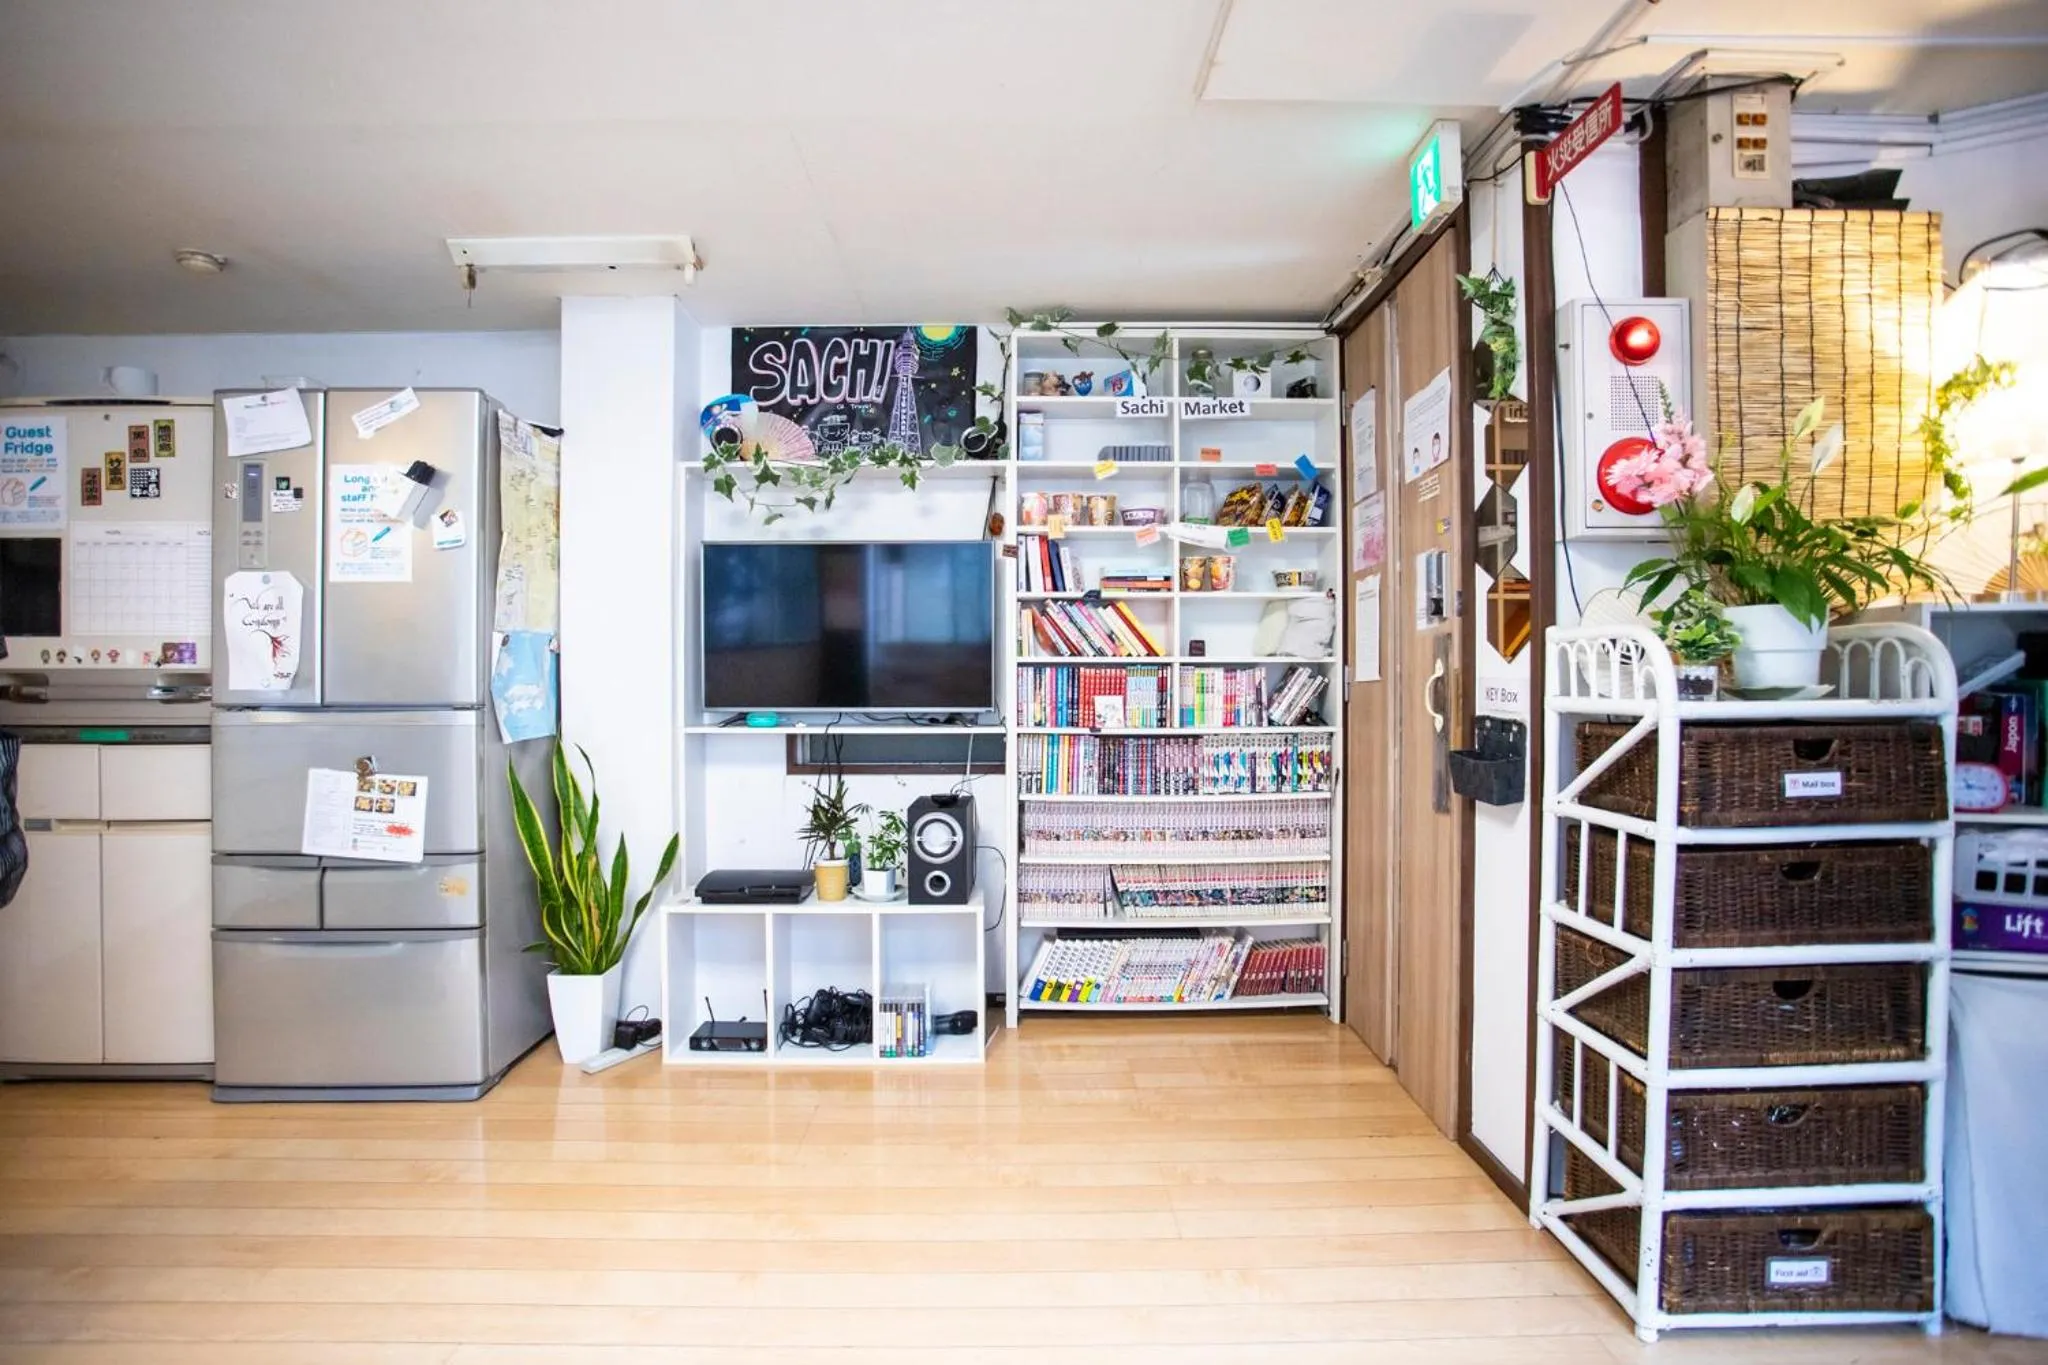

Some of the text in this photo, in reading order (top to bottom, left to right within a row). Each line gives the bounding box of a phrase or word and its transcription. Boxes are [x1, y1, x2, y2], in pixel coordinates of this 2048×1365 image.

[749, 337, 895, 406] SACHI
[1120, 400, 1246, 416] Sachi Market
[5, 426, 52, 439] Guest
[4, 441, 54, 456] Fridge
[344, 474, 370, 485] Long
[341, 493, 367, 502] staff
[1501, 687, 1518, 703] Box
[2005, 913, 2044, 938] Lift
